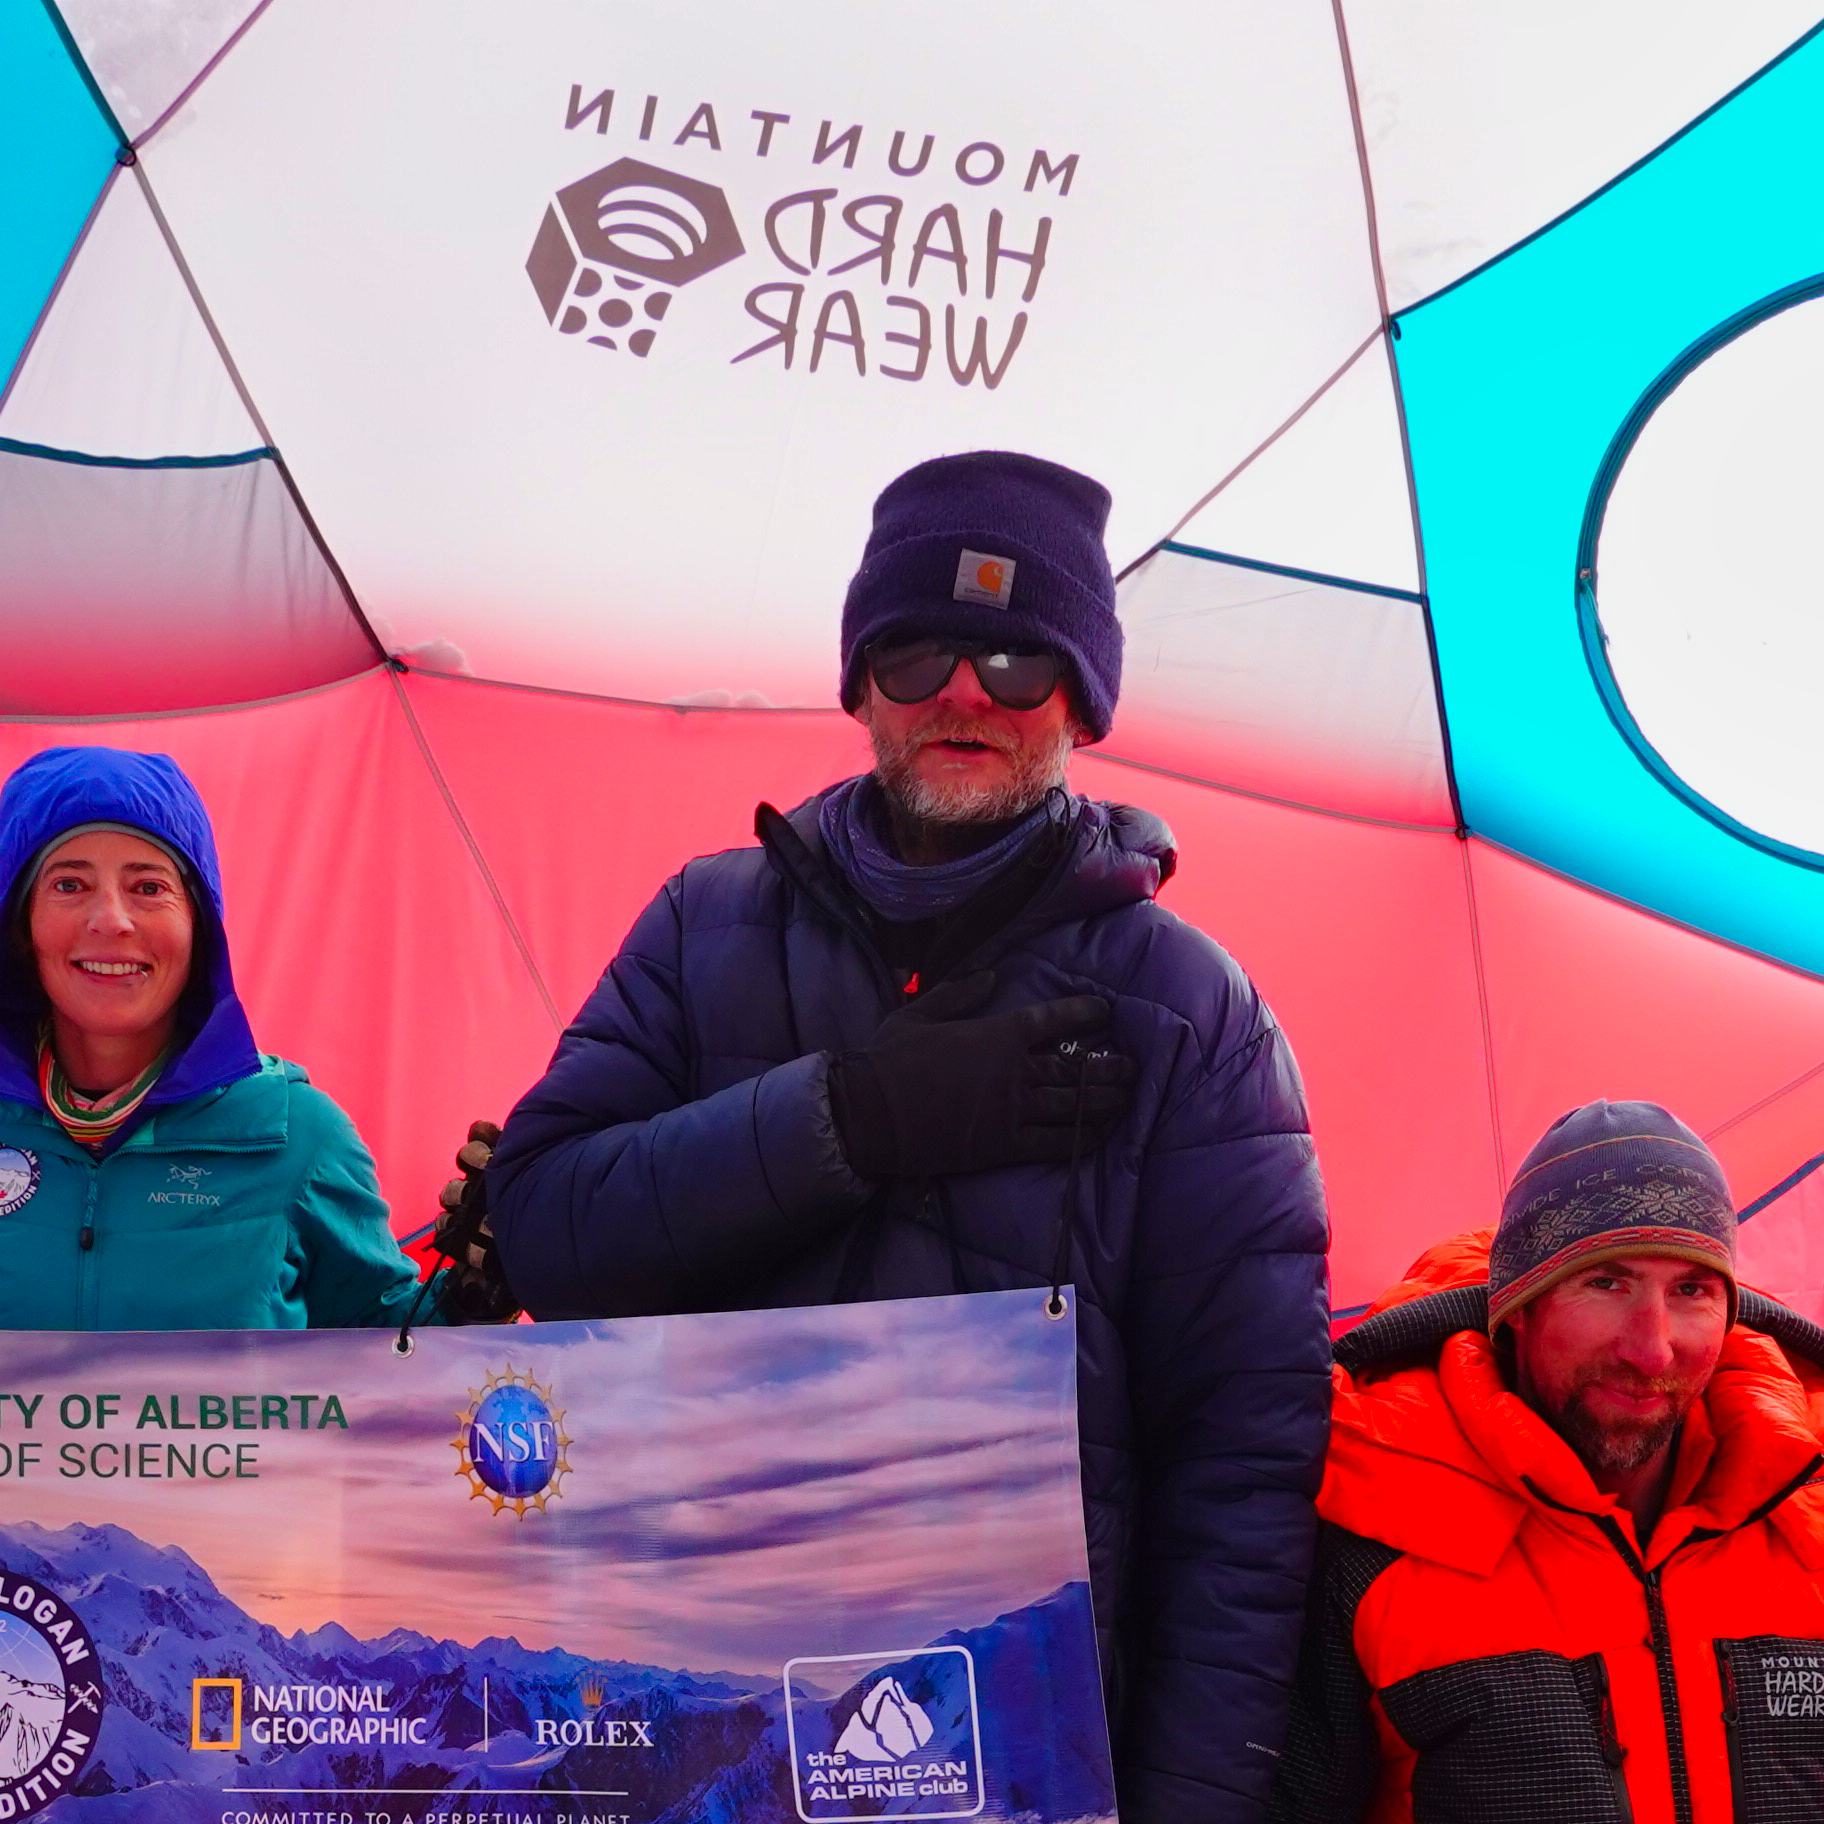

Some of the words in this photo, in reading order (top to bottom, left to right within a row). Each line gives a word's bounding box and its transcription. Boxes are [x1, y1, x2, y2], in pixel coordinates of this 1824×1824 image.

[59, 1394, 121, 1430] OF
[135, 1394, 350, 1430] ALBERTA
[472, 1420, 555, 1463] NSF
[58, 1442, 260, 1478] SCIENCE
[253, 1685, 391, 1713] NATIONAL
[250, 1716, 427, 1745] GEOGRAPHIC
[535, 1719, 655, 1748] ROLEX
[806, 1751, 847, 1767] the
[807, 1760, 968, 1785] AMERICAN
[809, 1781, 916, 1801] ALPINE
[919, 1778, 969, 1796] club
